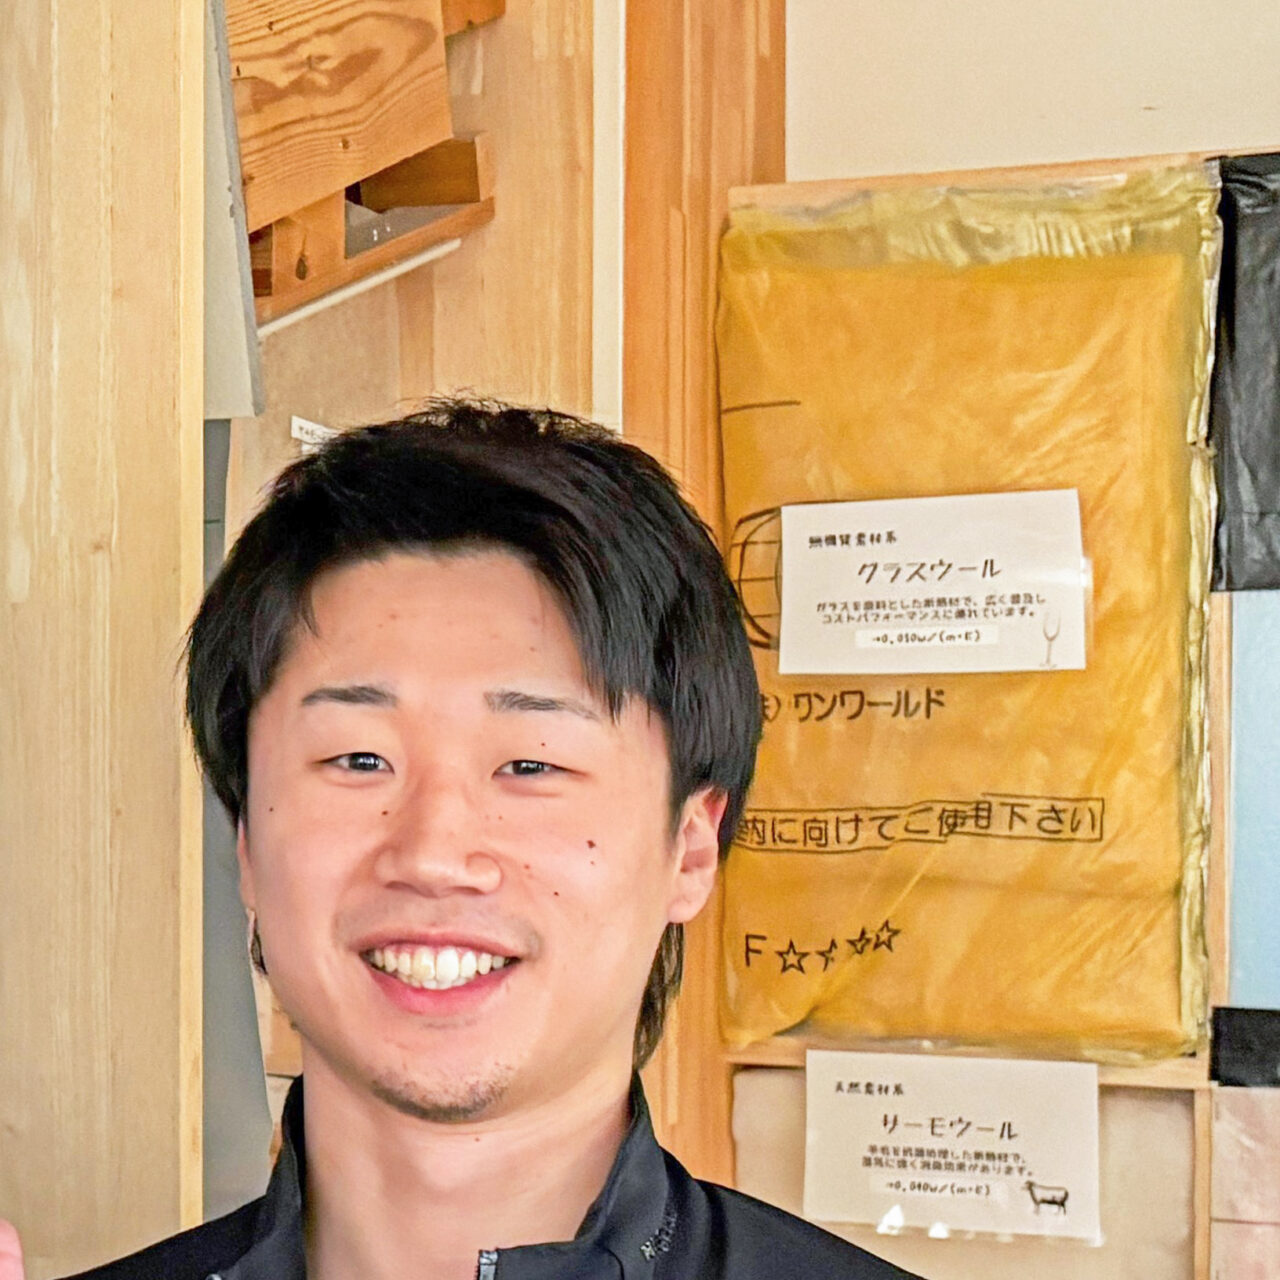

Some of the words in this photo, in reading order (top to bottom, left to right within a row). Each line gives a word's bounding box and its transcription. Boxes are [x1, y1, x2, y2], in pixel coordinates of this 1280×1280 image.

[856, 558, 1002, 584] グラスウール
[793, 687, 946, 722] ワンワールド
[881, 1113, 1019, 1141] リーモウール
